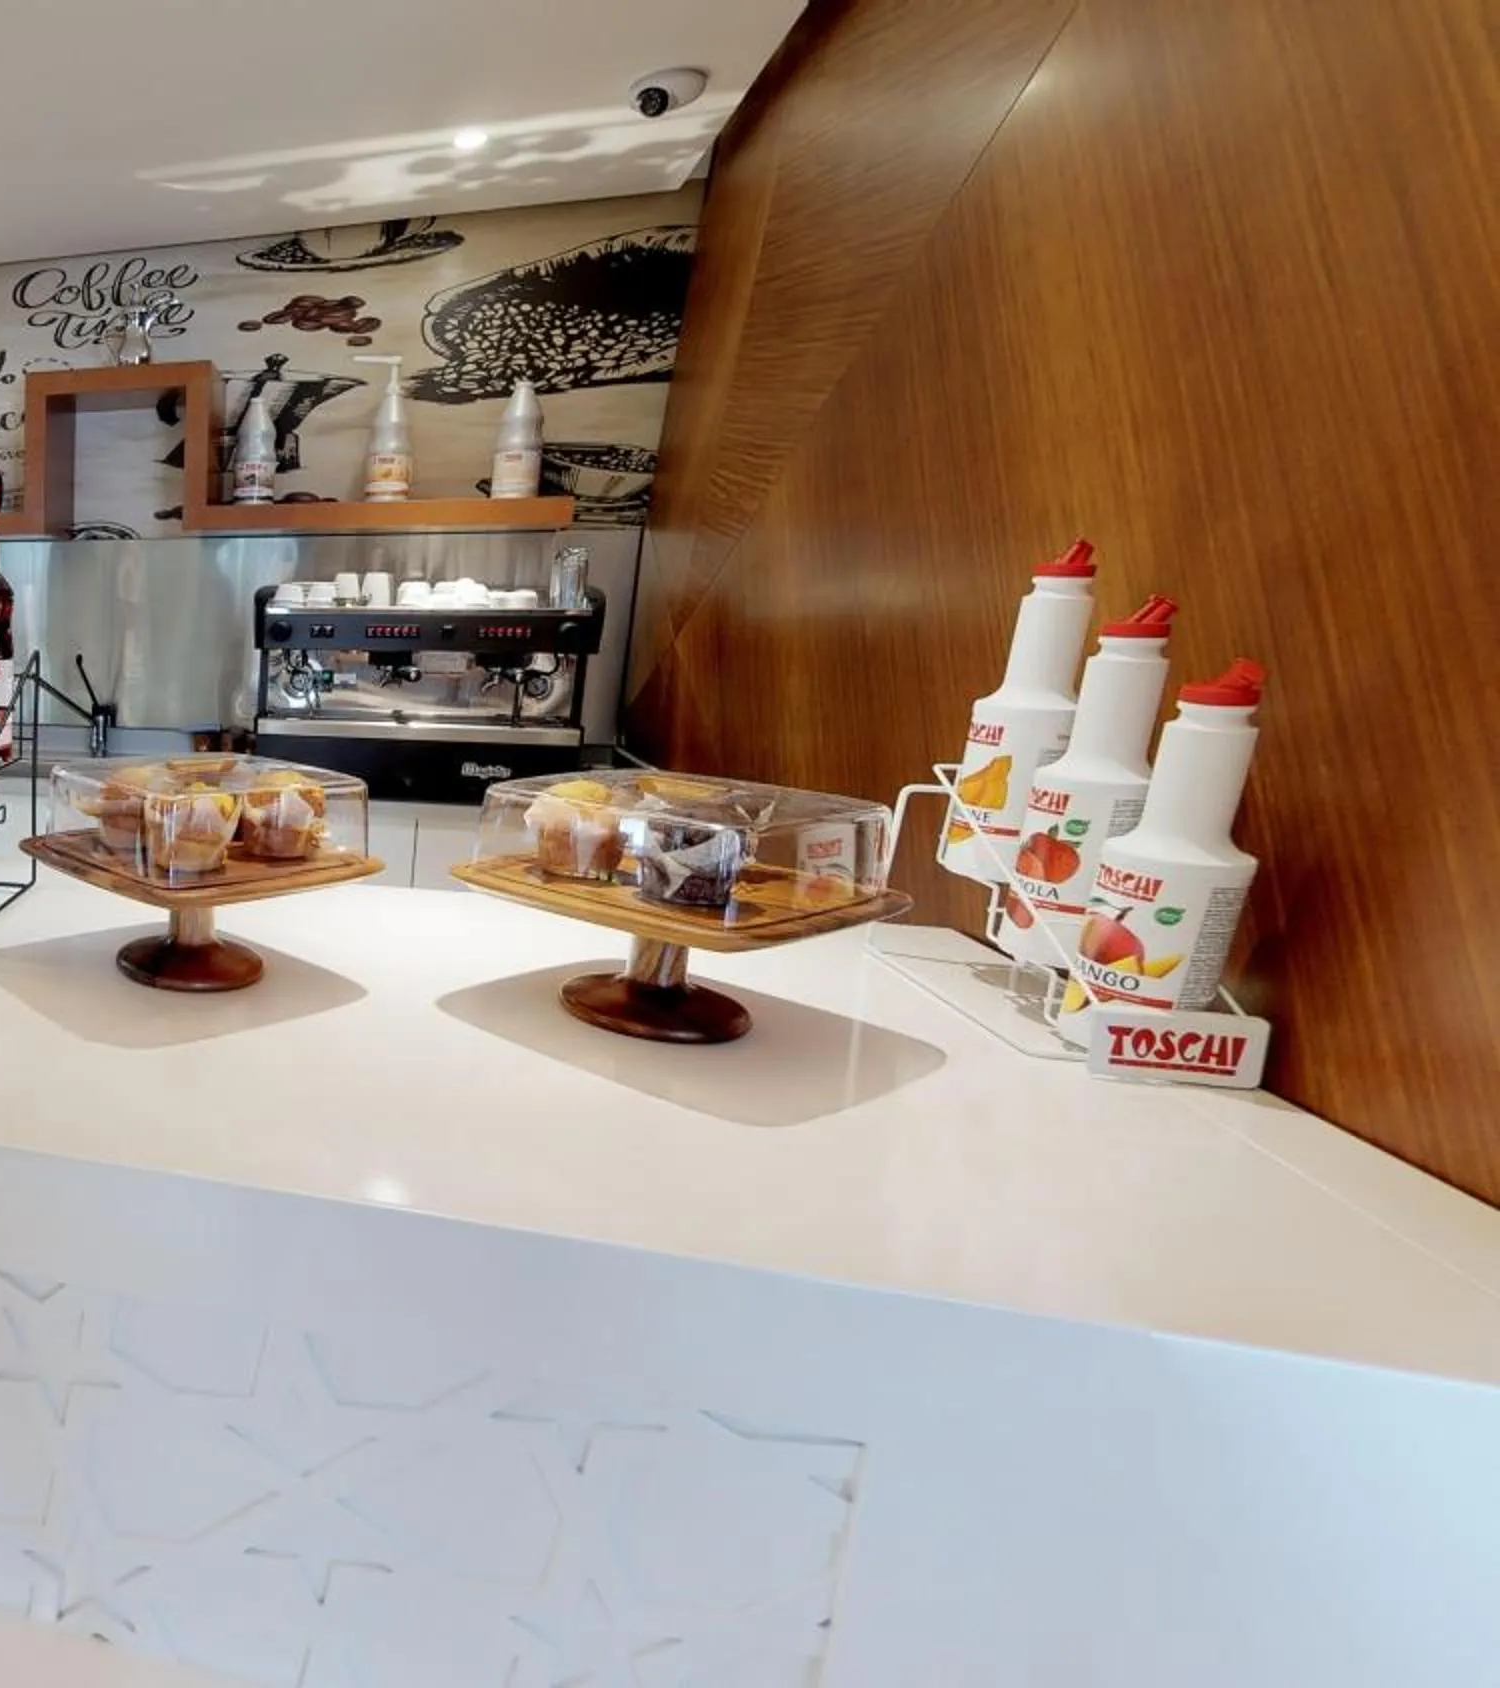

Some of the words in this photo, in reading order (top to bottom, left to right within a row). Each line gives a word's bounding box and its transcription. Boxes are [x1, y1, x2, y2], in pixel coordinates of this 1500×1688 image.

[11, 257, 199, 312] Coffee
[1097, 863, 1165, 898] TOSCHI
[1073, 957, 1140, 991] ANGO
[1107, 1025, 1249, 1068] TOSCHI
